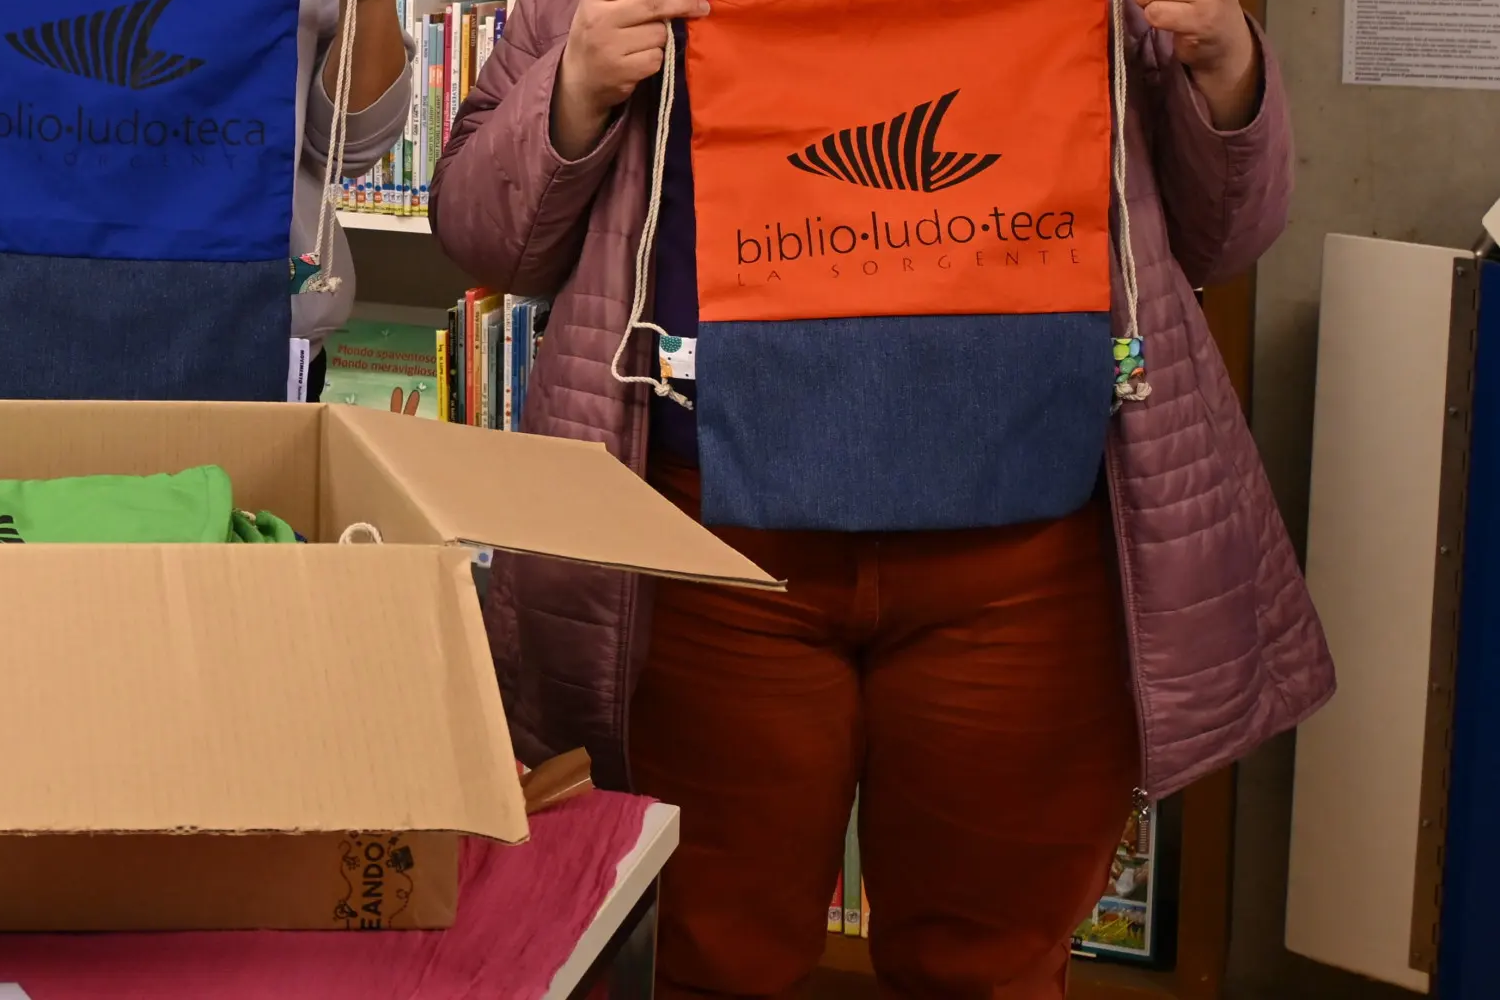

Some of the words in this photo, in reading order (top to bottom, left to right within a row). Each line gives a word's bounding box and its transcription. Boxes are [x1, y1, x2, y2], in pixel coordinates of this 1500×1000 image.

[737, 269, 782, 287] LA
[830, 247, 1081, 279] SORGENTE
[337, 342, 374, 358] Mondo
[374, 347, 437, 365] spaventoso
[332, 355, 367, 370] Mondo
[369, 361, 438, 379] meraviglioso
